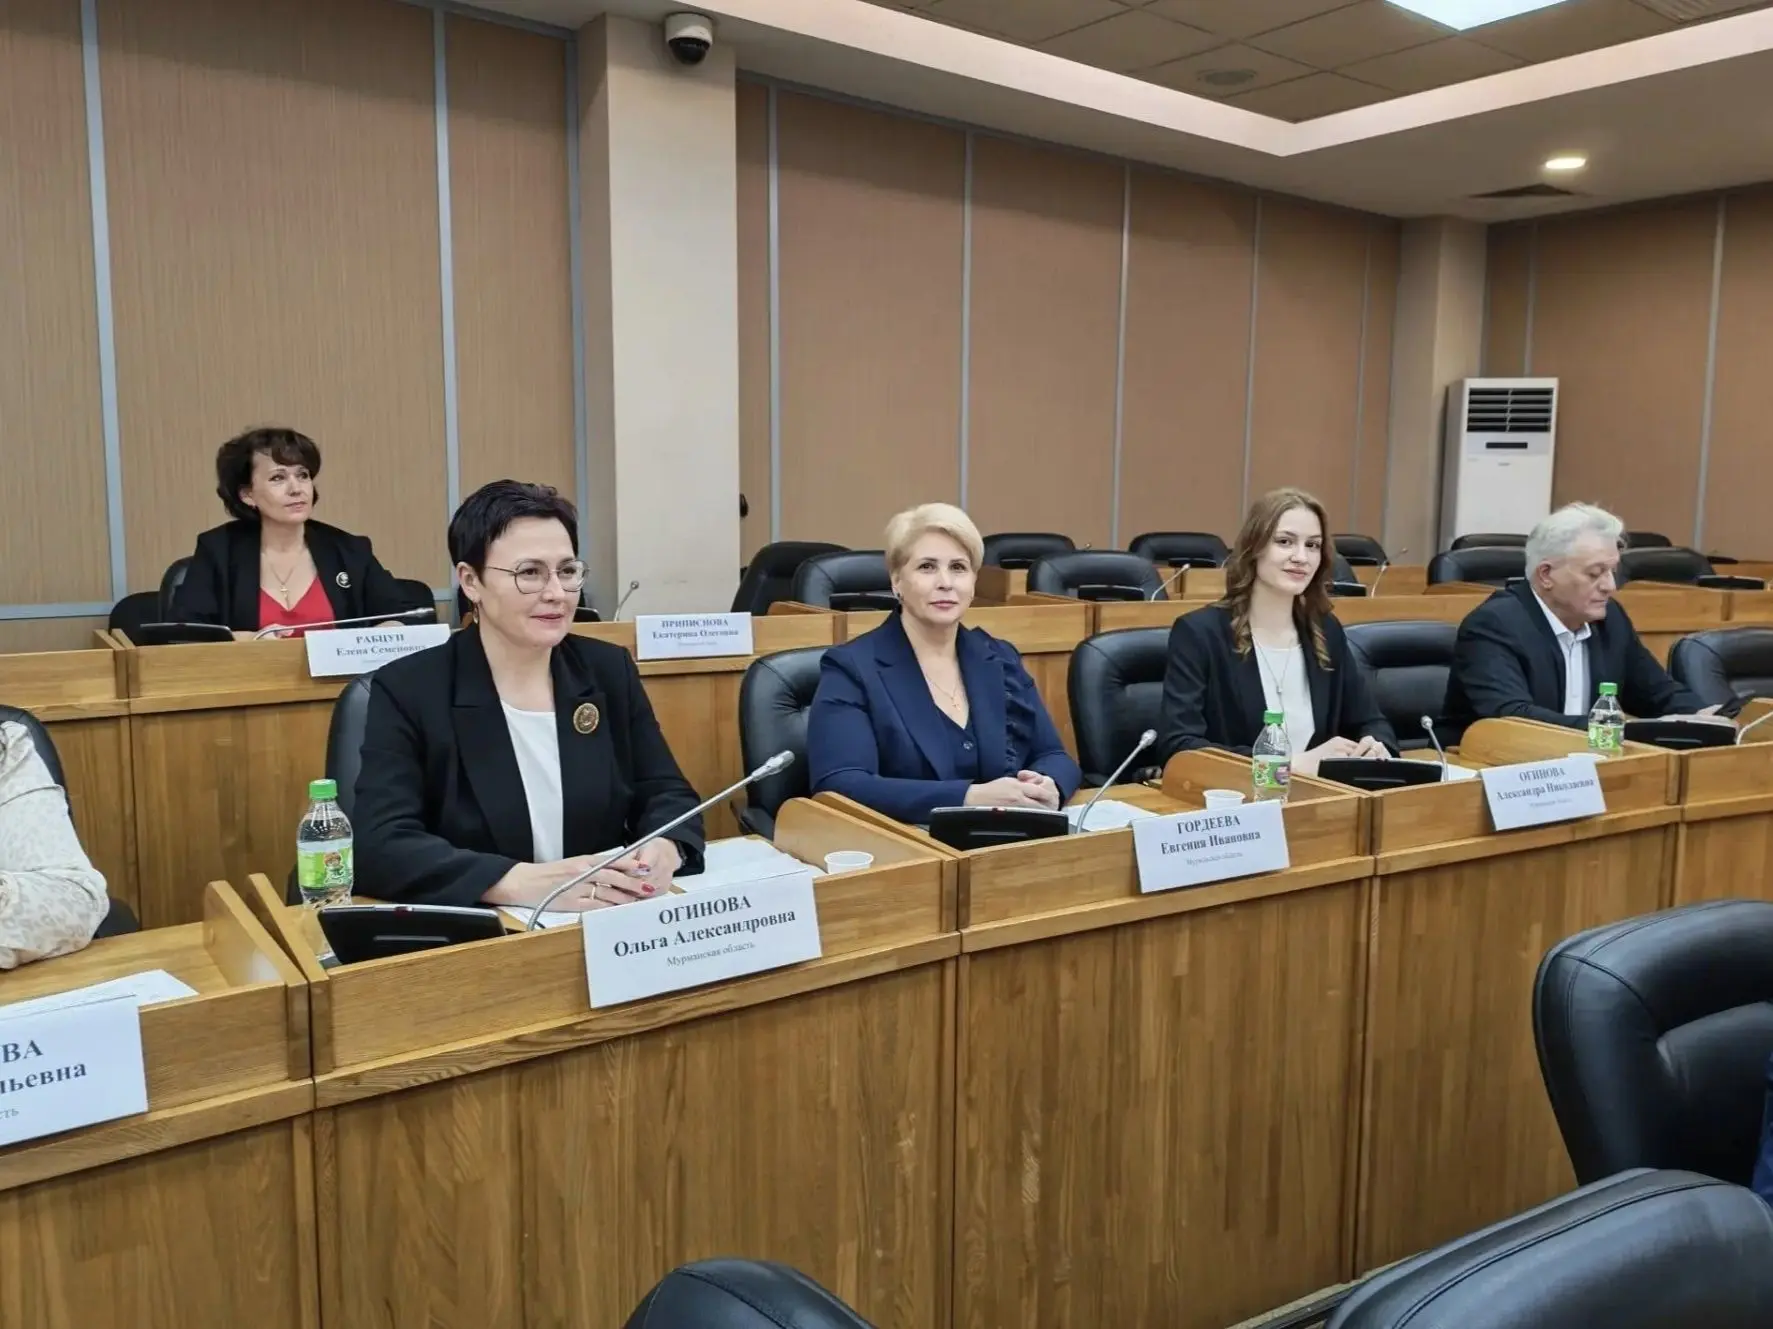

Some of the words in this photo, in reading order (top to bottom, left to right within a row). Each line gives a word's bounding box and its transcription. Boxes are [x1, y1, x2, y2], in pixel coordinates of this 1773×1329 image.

[336, 646, 368, 657] Елена
[1519, 767, 1566, 782] ОГИНОВА
[1497, 785, 1546, 802] Александра
[1546, 778, 1594, 794] Николаевна
[1177, 815, 1241, 835] ГОРДЕЕВА
[1160, 839, 1207, 855] Евгения
[1208, 831, 1261, 847] Ивановна
[658, 895, 752, 925] ОГИНОВА
[613, 935, 669, 958] Ольга
[673, 910, 796, 946] Александровна
[722, 941, 756, 955] область
